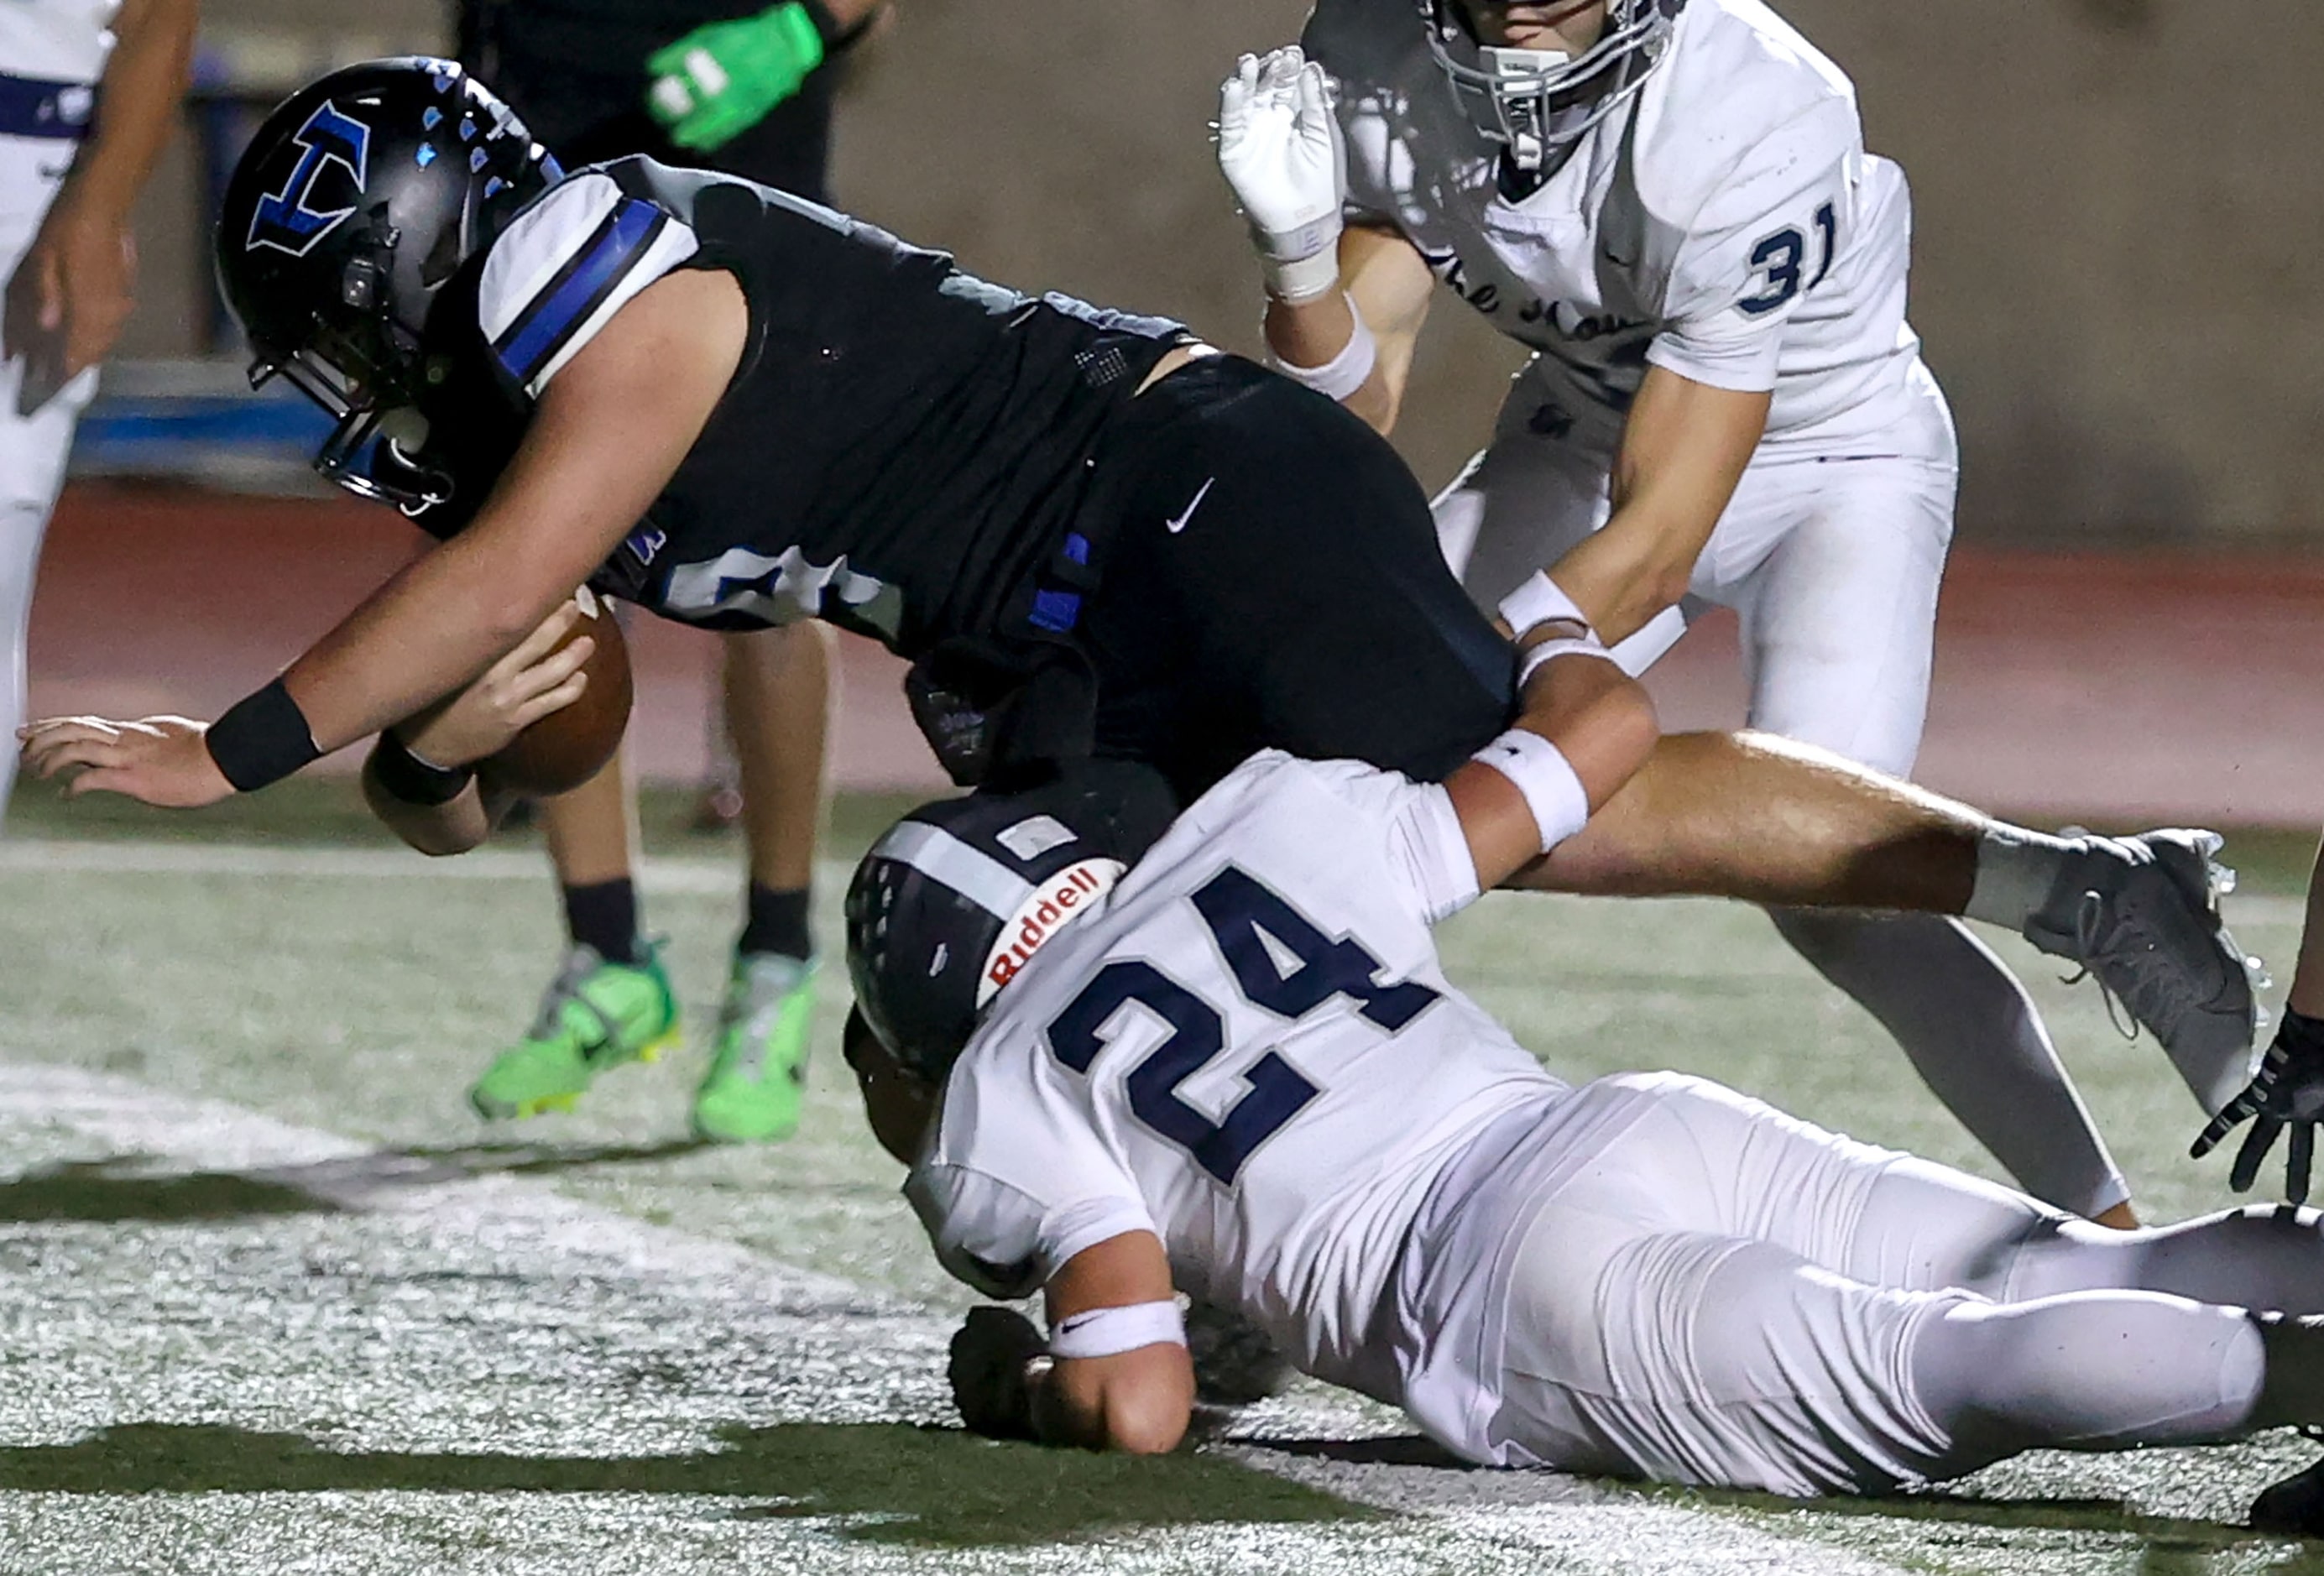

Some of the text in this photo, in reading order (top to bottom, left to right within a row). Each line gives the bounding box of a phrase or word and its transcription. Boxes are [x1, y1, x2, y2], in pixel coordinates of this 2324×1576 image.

[1734, 198, 1836, 321] 31
[987, 867, 1099, 987] Riddell
[1041, 859, 1449, 1187] 24
